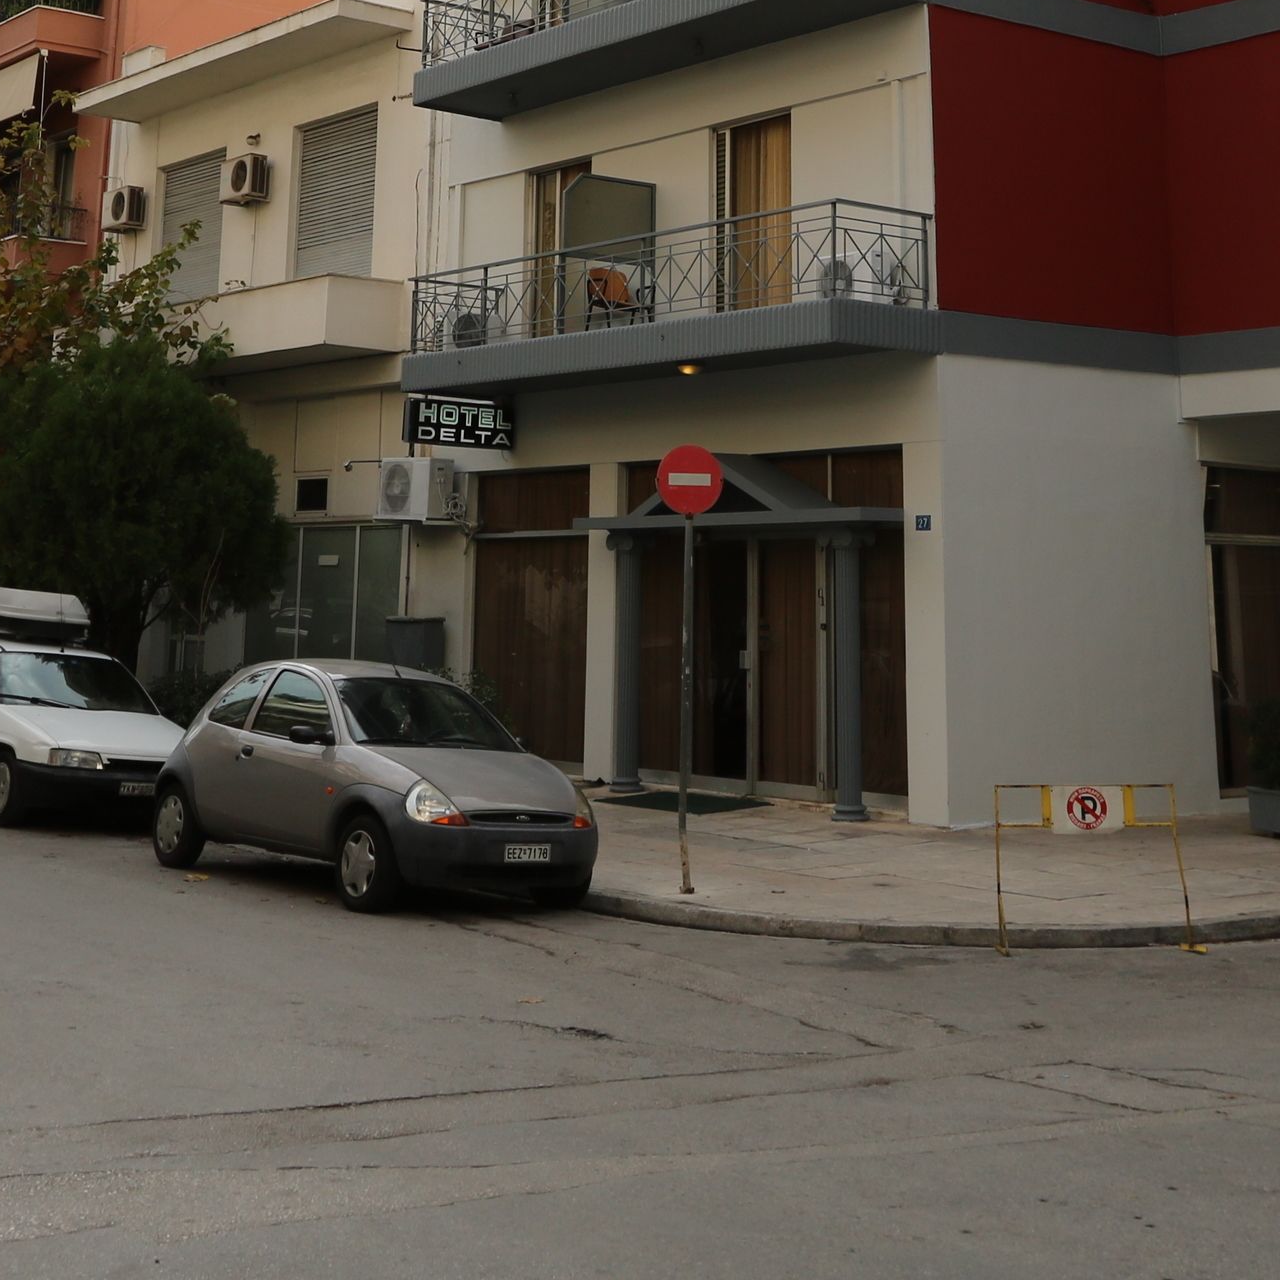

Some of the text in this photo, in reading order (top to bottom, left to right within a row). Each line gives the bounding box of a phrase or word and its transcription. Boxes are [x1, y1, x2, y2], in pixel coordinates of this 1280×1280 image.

[419, 402, 512, 429] HOTEL
[417, 426, 511, 446] DELTA
[917, 517, 928, 529] 27
